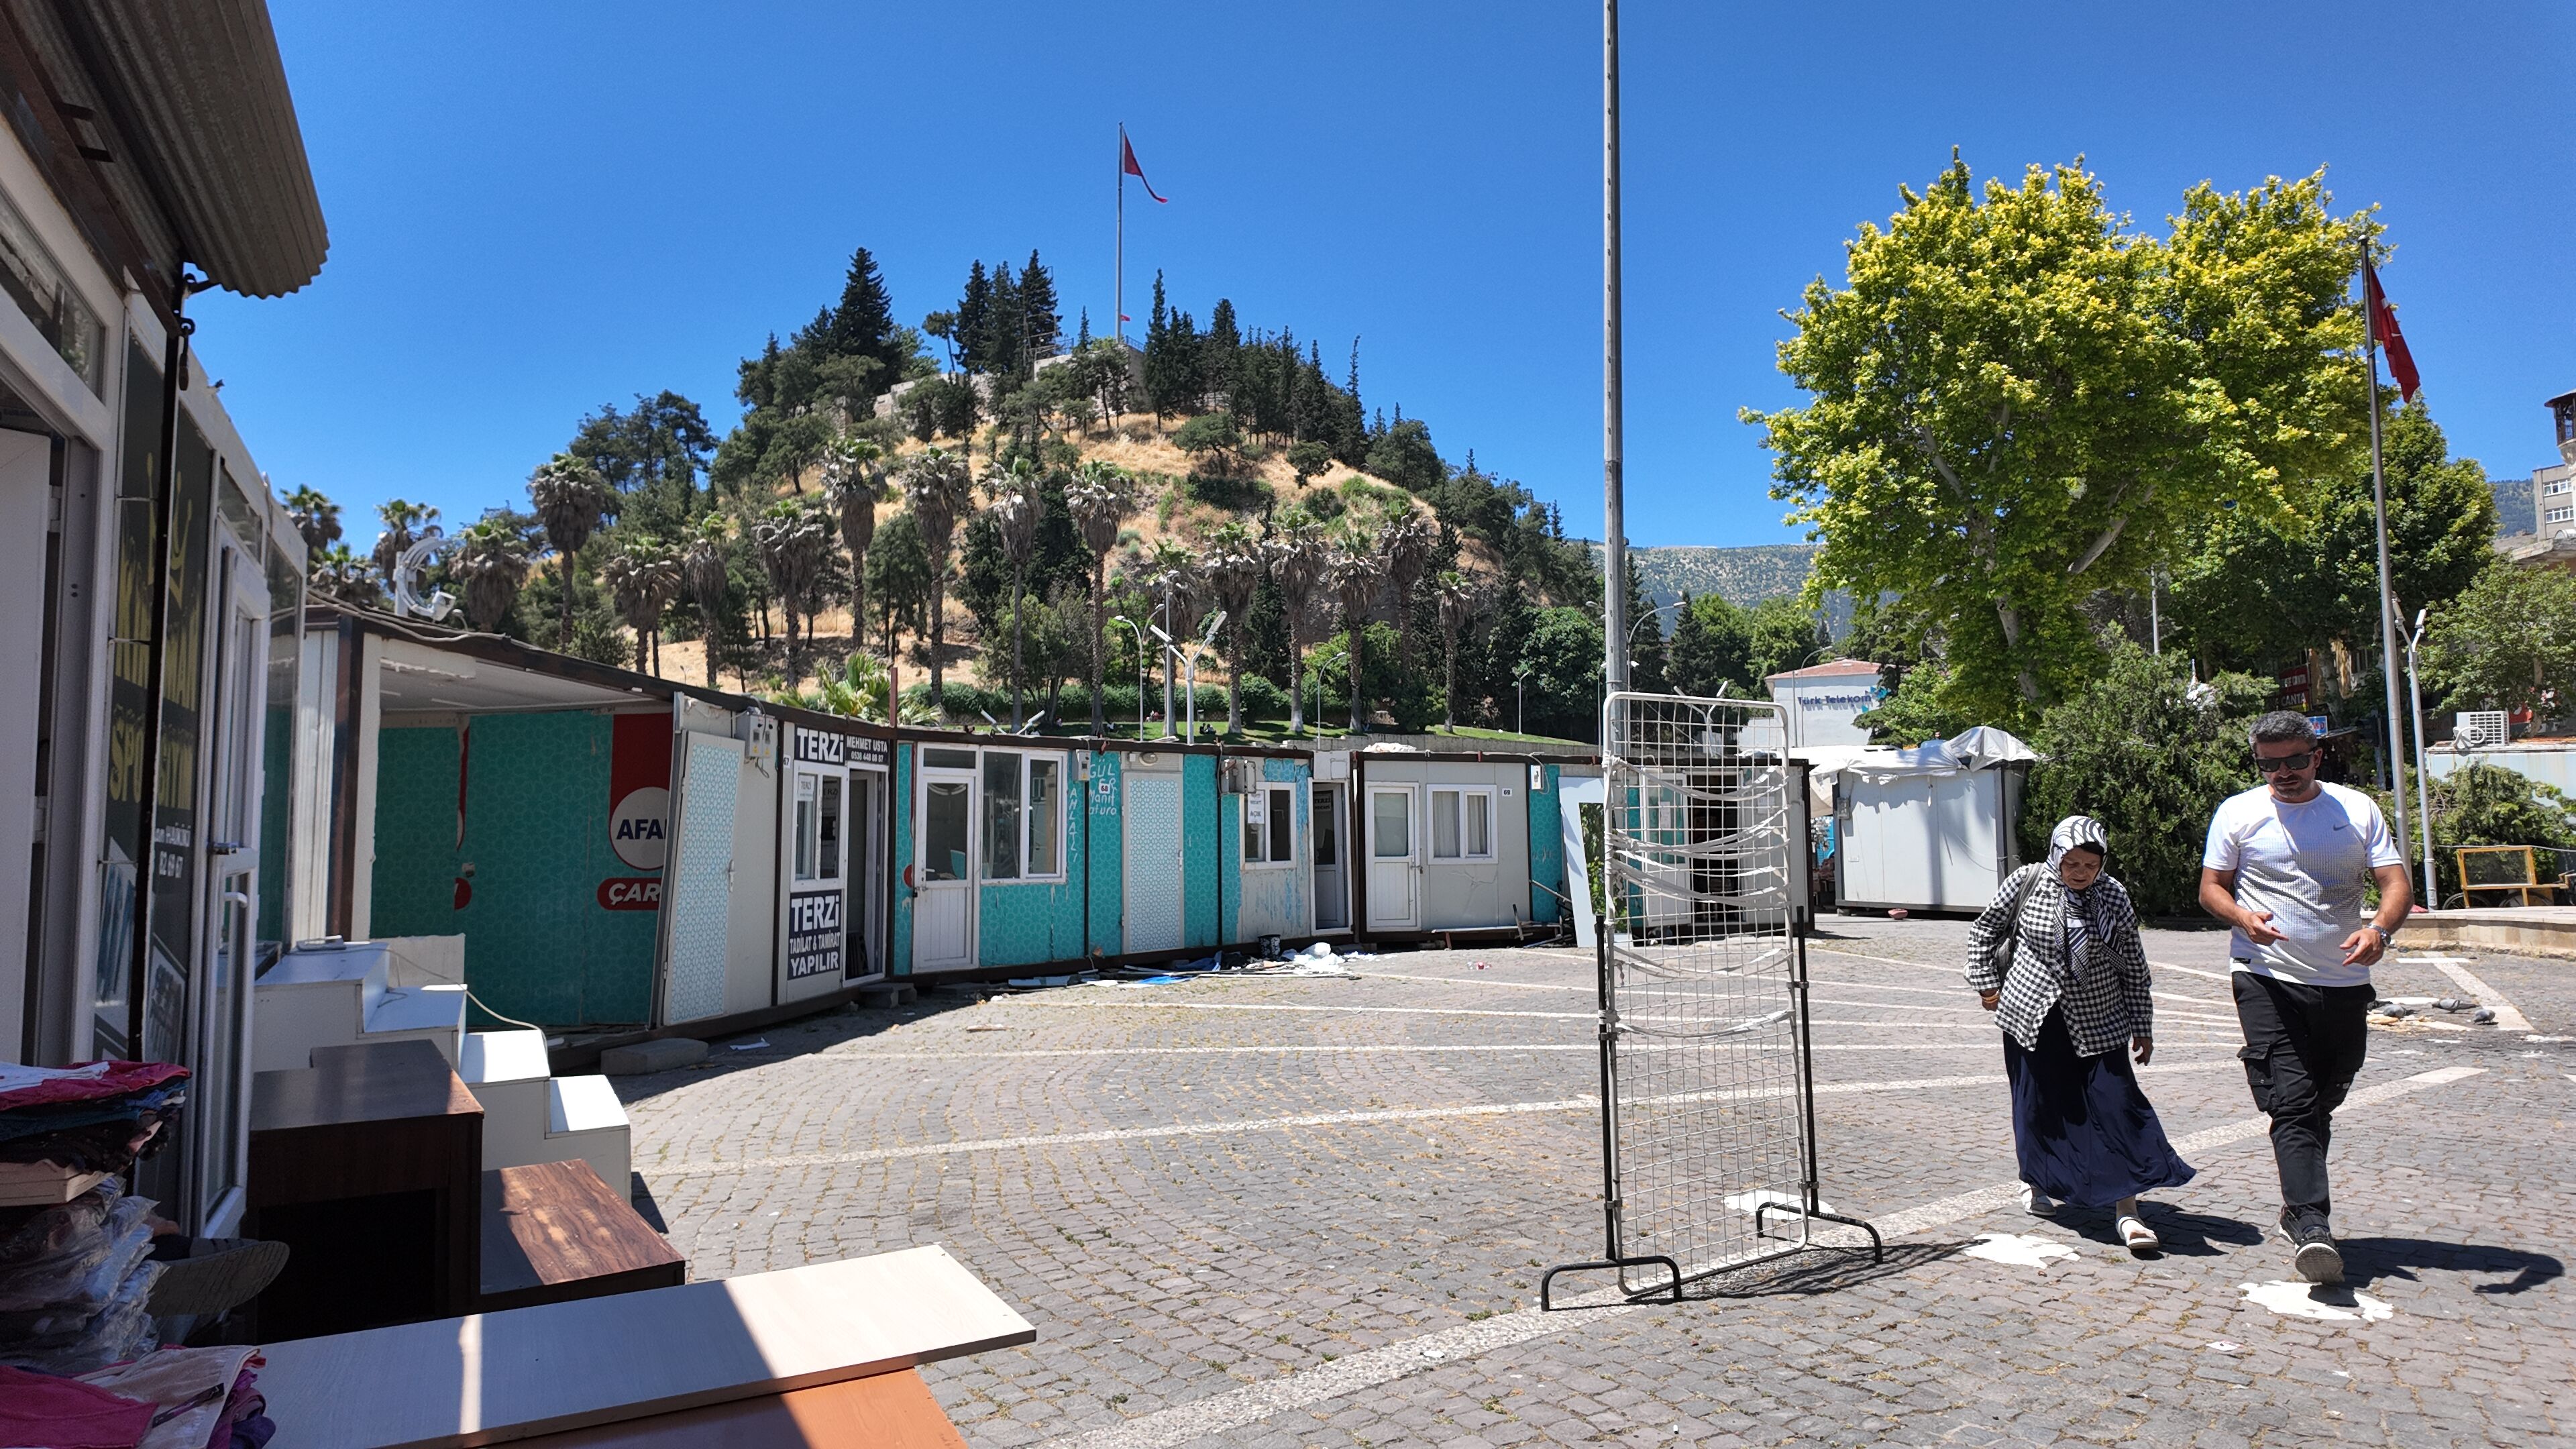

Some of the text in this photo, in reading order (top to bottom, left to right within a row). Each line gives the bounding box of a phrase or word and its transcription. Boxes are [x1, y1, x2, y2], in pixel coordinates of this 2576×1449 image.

[1798, 694, 1872, 704] Türk Telekom
[847, 735, 888, 753] MEHMET USTA
[1089, 759, 1115, 779] GÜL
[616, 818, 667, 840] AFA
[790, 933, 812, 955] TADİLAT
[818, 930, 841, 949] TAMİRAT
[790, 951, 839, 977] YAPILIR
